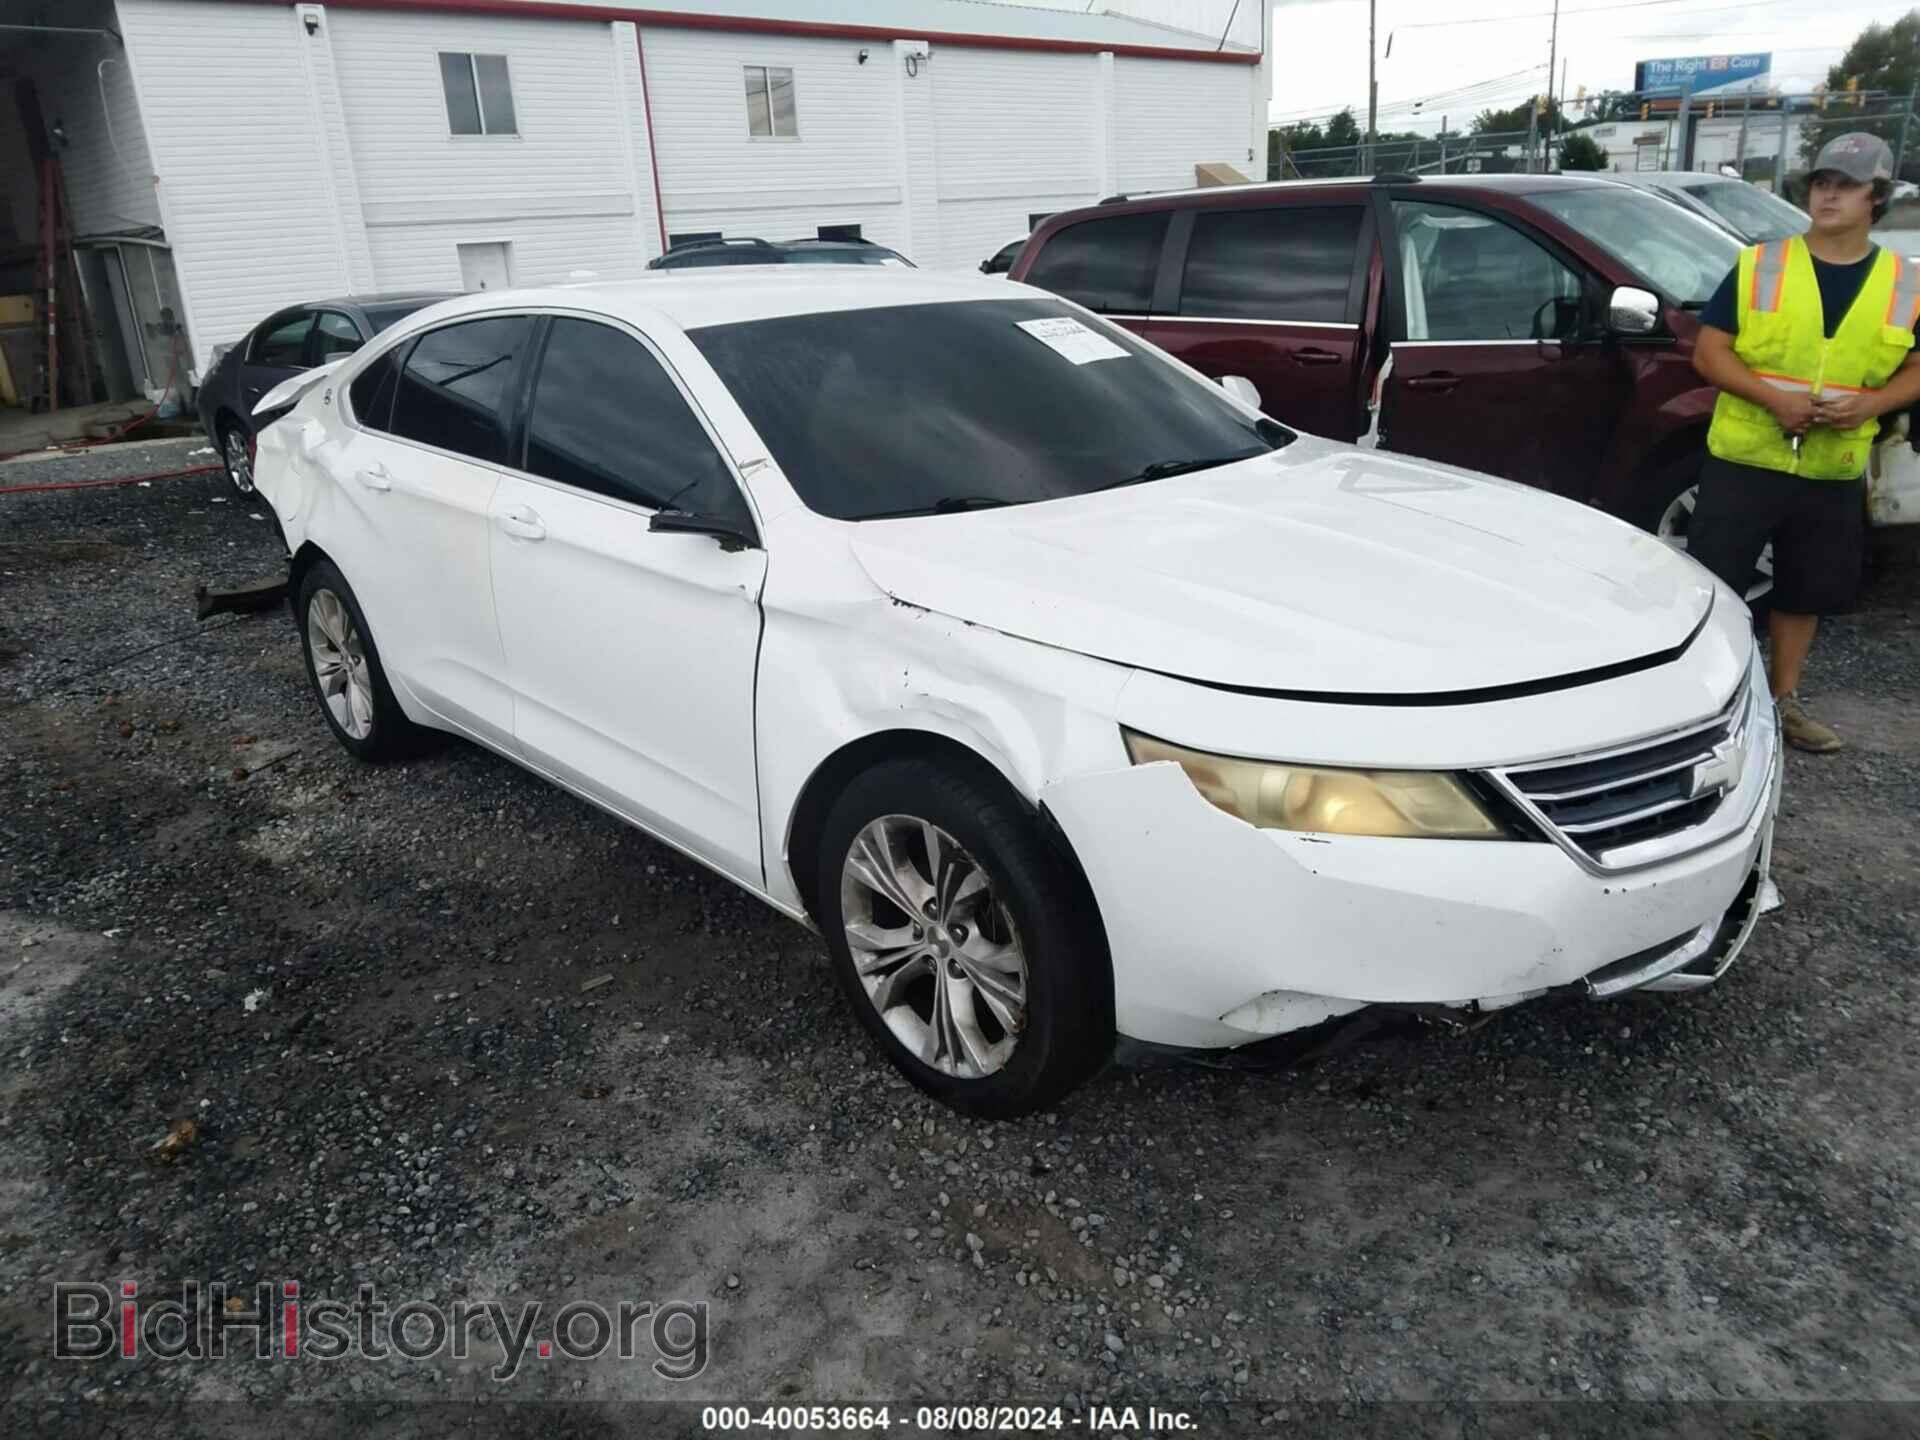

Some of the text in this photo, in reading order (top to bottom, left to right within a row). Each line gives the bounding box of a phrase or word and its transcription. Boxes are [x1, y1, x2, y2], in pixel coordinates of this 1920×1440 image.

[1650, 54, 1760, 74] The Right ER Care
